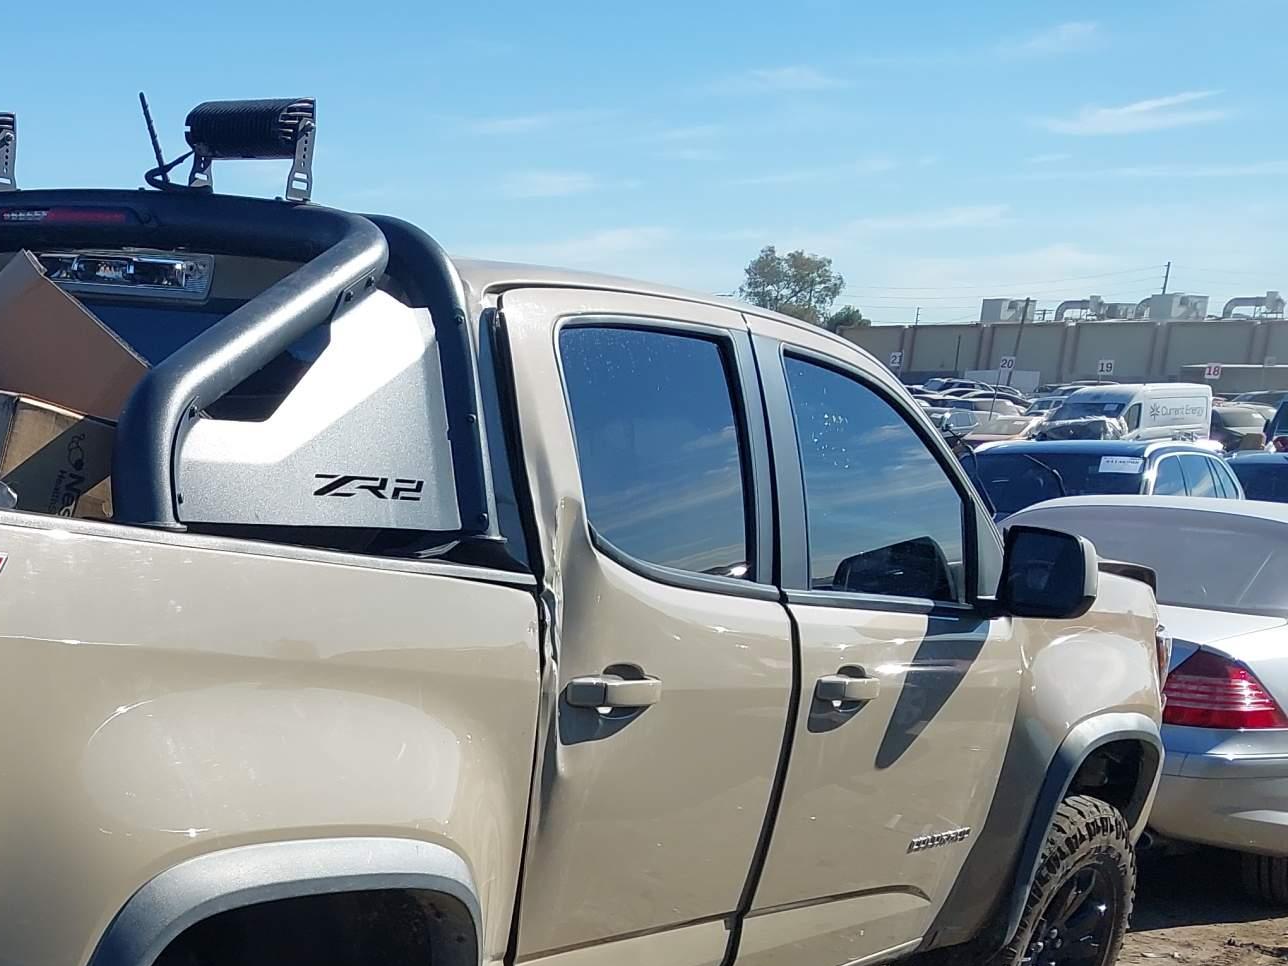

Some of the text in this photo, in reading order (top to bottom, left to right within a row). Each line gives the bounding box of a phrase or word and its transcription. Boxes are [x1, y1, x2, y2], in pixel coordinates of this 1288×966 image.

[1000, 358, 1014, 369] 20
[1099, 362, 1112, 373] 19
[1206, 365, 1220, 377] 18
[313, 474, 424, 501] ZR2
